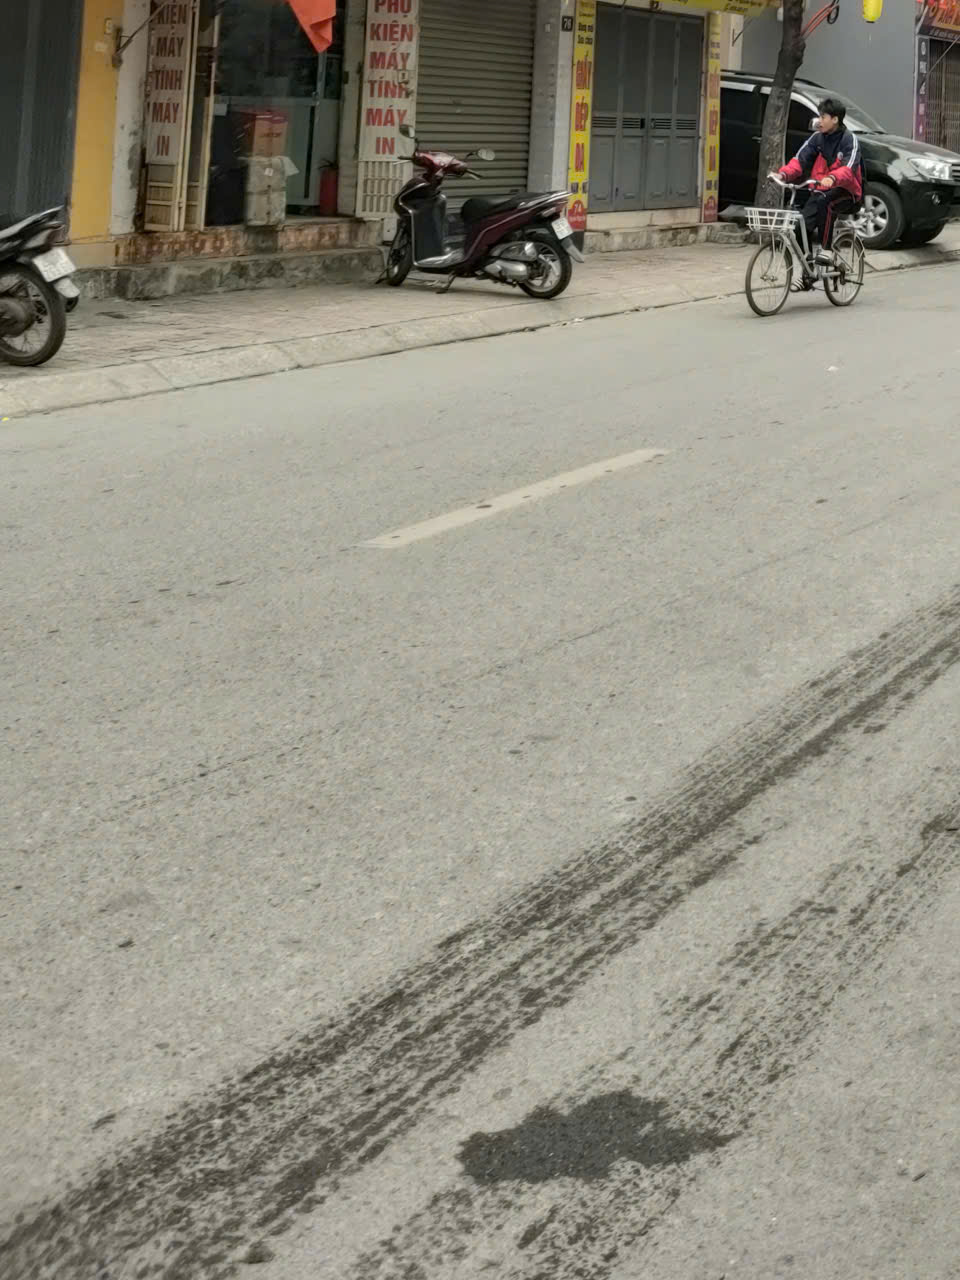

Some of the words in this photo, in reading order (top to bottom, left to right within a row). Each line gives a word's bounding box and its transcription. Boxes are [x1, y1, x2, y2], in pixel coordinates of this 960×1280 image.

[370, 20, 414, 45] KIỆN
[156, 32, 184, 57] MÁY
[369, 47, 410, 70] MÁY
[154, 64, 183, 90] TÍNH
[368, 76, 410, 98] TÍNH
[151, 98, 180, 123] MÁY
[365, 104, 408, 127] MÁY
[156, 136, 170, 156] IN
[375, 137, 395, 155] IN
